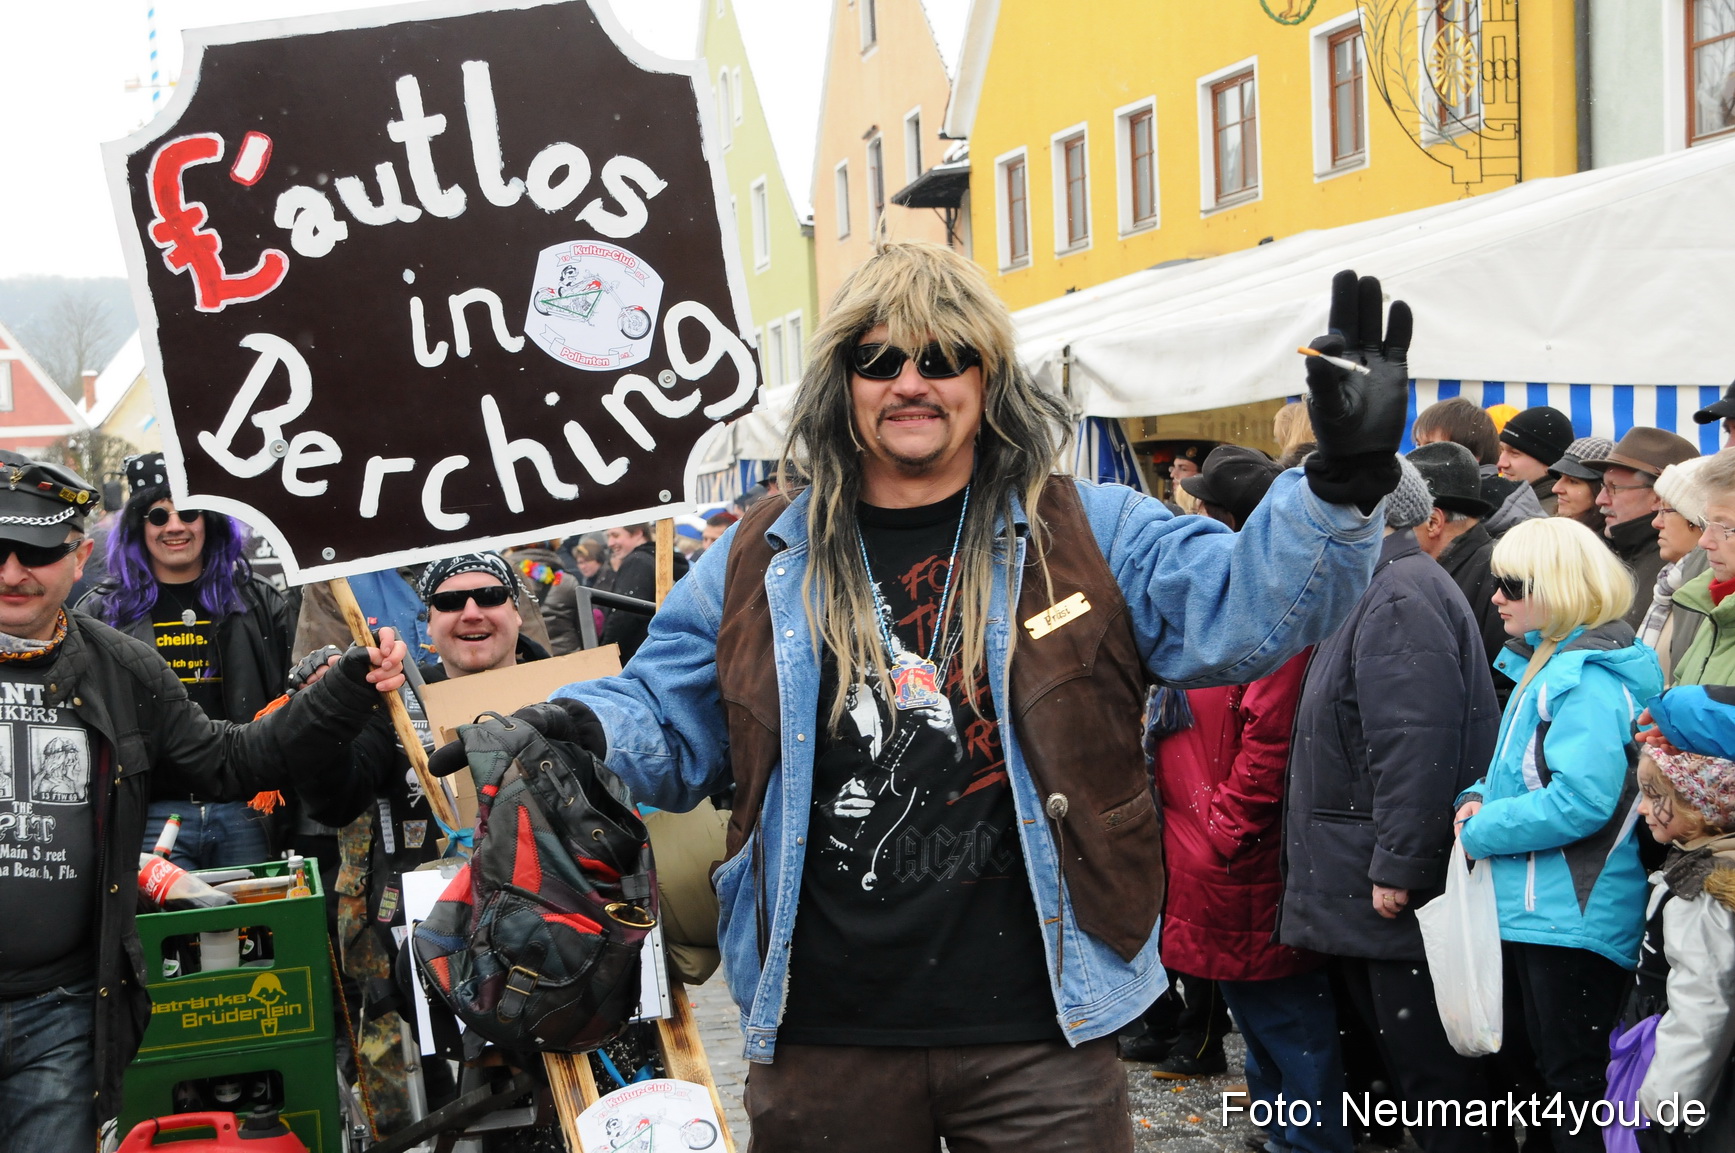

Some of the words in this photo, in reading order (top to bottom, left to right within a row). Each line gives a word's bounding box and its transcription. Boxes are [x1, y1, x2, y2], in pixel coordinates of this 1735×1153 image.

[573, 245, 636, 269] Kultur-Club
[403, 268, 526, 368] in
[560, 347, 610, 367] Pollanten
[197, 300, 758, 531] Berching
[156, 632, 208, 647] cheiße.
[173, 659, 186, 668] ich
[188, 659, 203, 669] gut
[0, 682, 45, 706] NT
[12, 801, 33, 815] THE
[0, 843, 28, 859] Main
[58, 865, 78, 880] Fla.
[182, 1001, 302, 1029] Brüderlein
[606, 1082, 672, 1109] Kultur-Club
